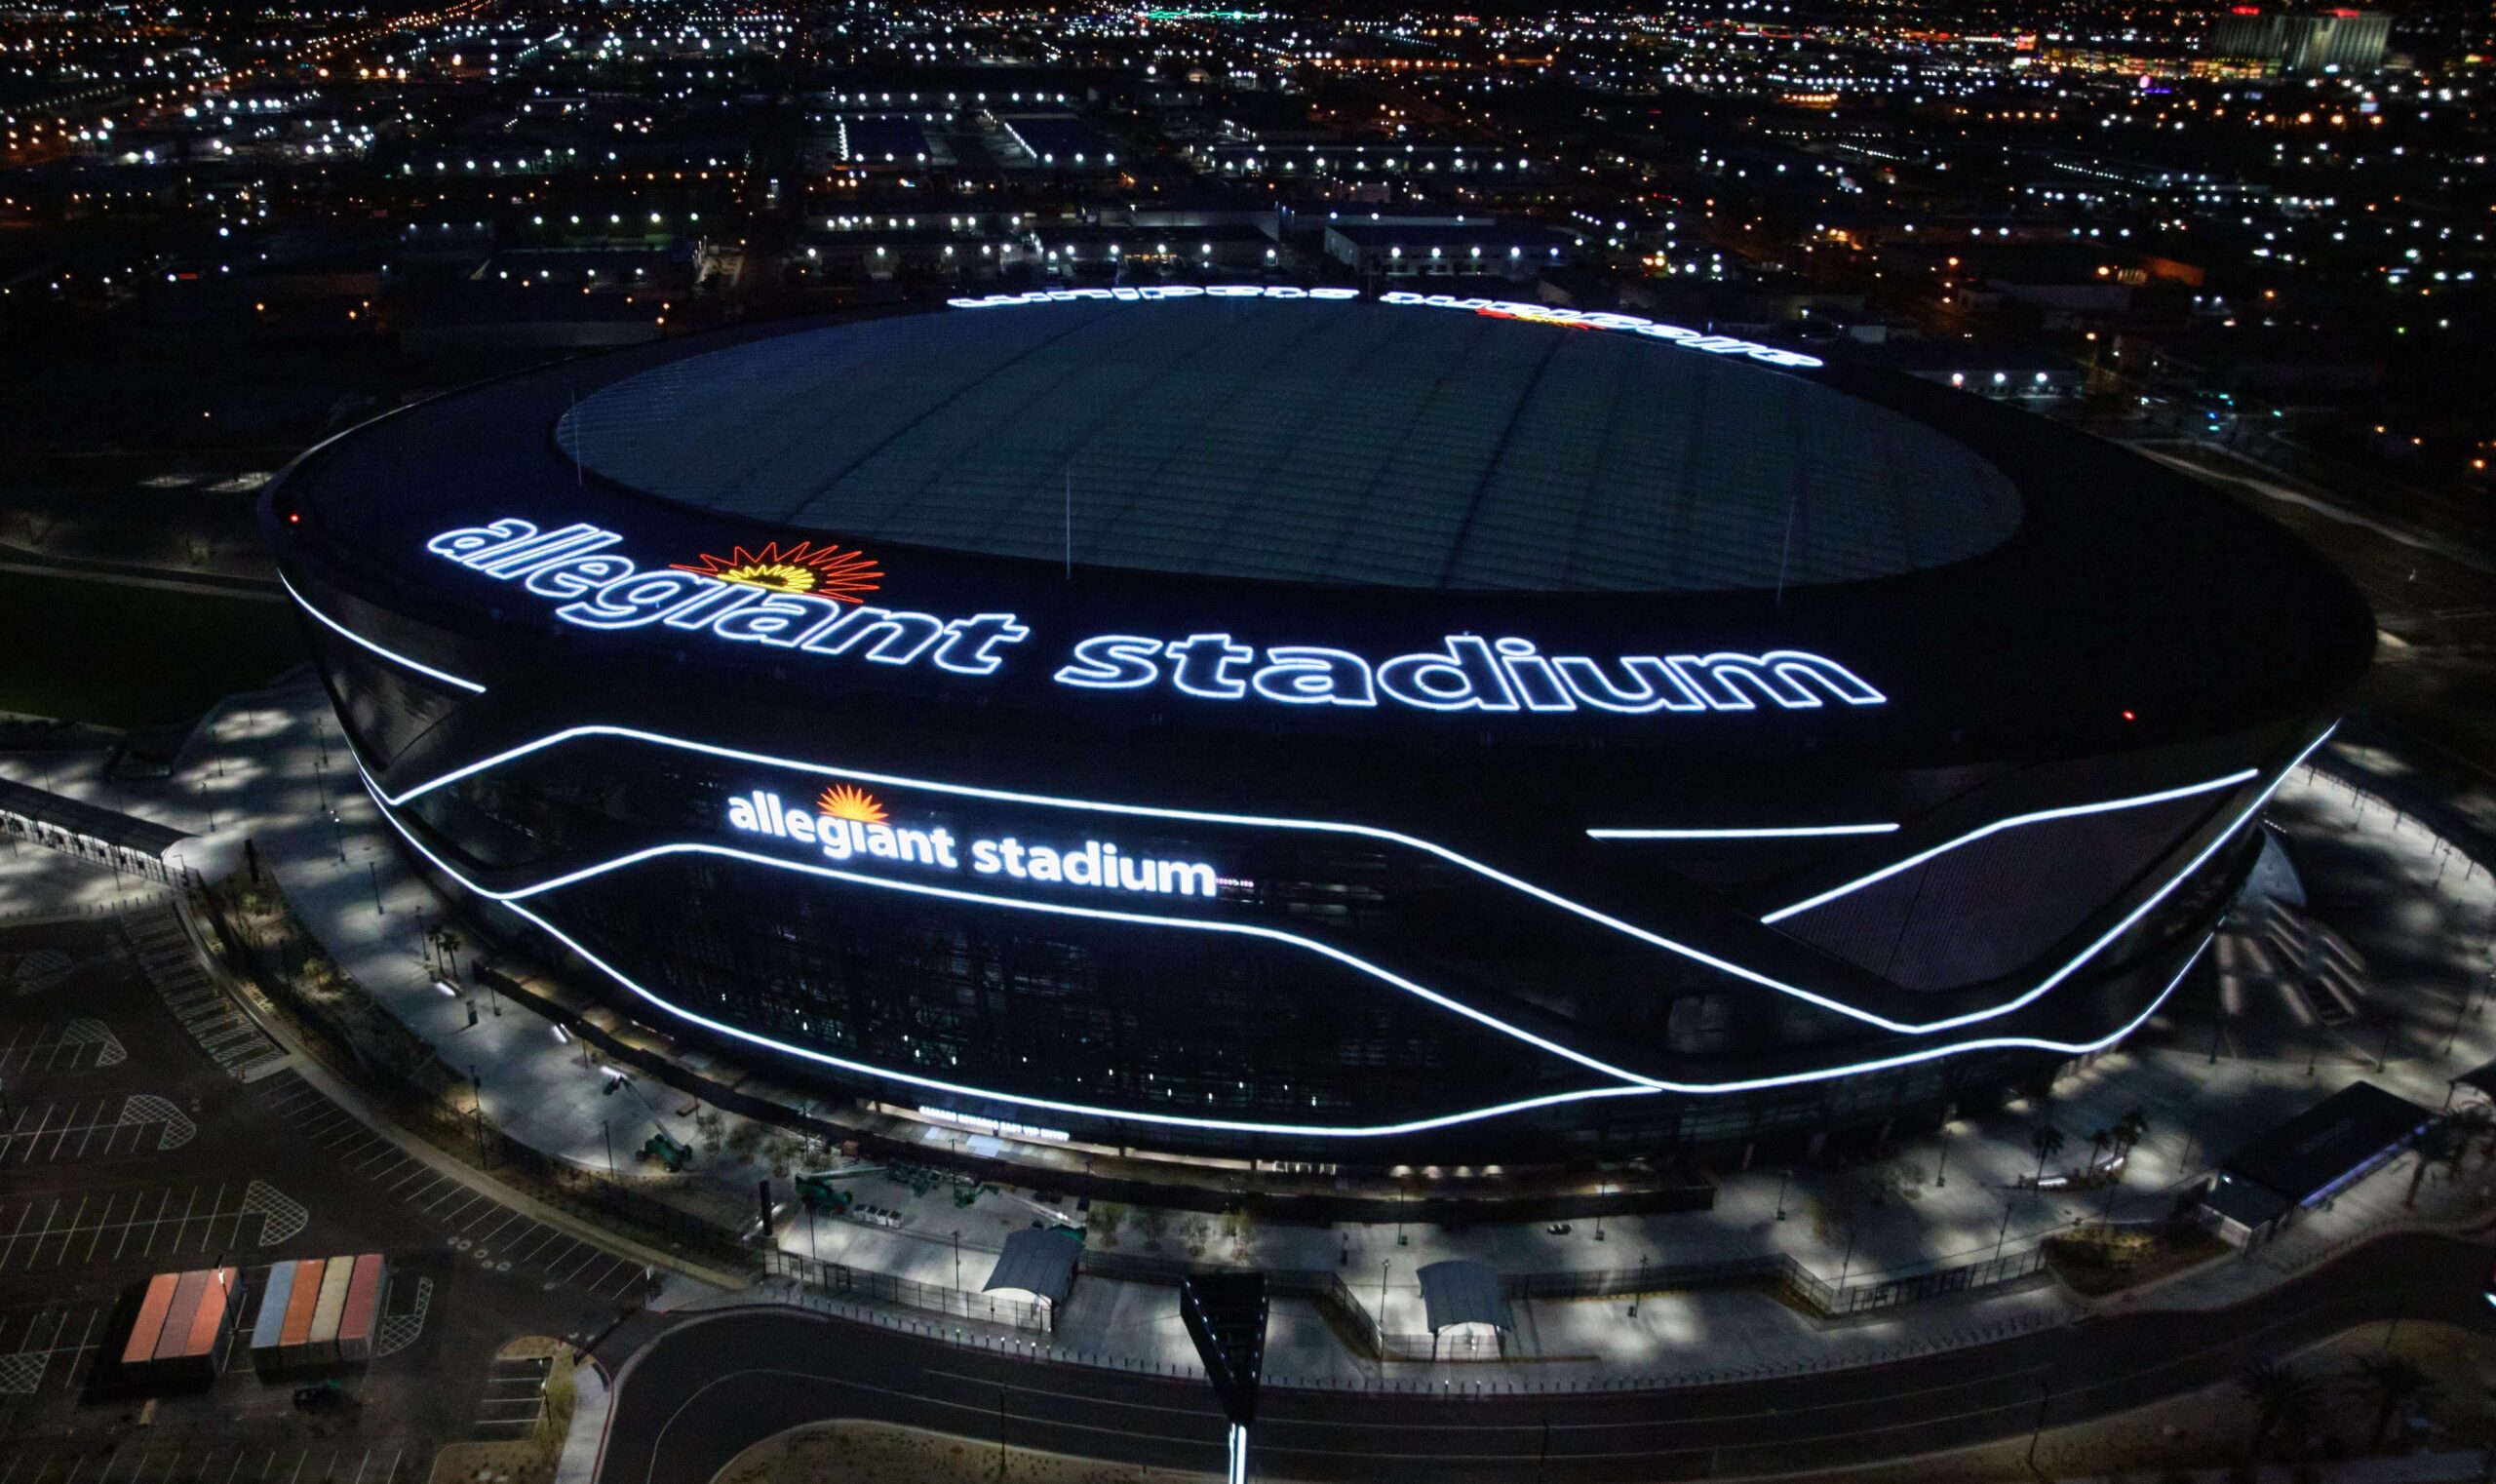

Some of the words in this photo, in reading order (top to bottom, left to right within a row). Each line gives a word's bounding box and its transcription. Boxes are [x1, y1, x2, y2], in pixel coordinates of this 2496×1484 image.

[427, 518, 1030, 675] allegiant
[1053, 632, 1888, 714] stadium
[726, 790, 958, 869] allegiant
[972, 836, 1219, 897] stadium
